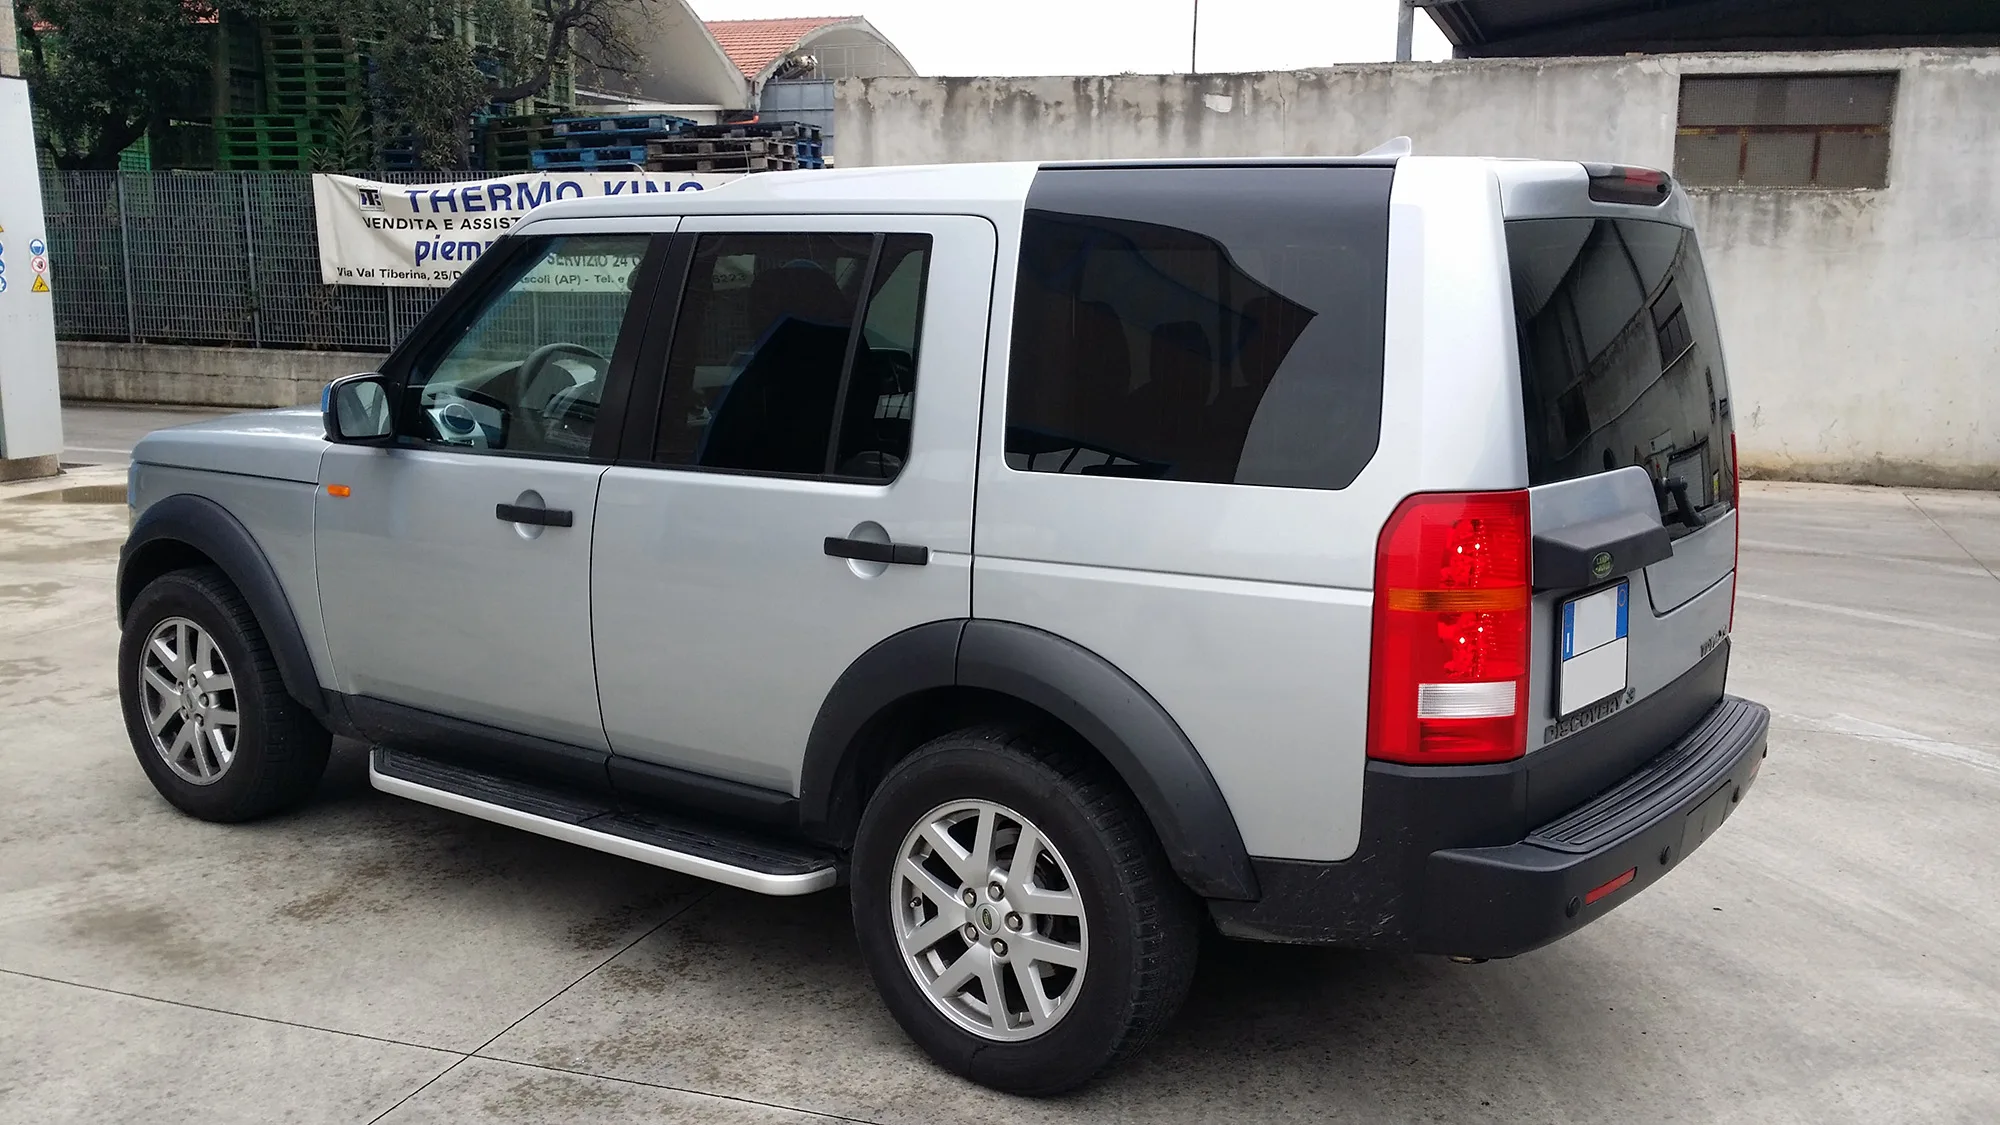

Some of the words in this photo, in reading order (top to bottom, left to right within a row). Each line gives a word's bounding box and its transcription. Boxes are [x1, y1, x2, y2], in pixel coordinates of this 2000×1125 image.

[404, 181, 583, 213] THERMO
[362, 217, 437, 230] VENDITA
[444, 219, 453, 230] E
[547, 252, 607, 267] SERVIZIO
[612, 255, 628, 267] 24
[337, 267, 353, 277] Via
[357, 268, 375, 278] Val
[379, 269, 430, 281] Tiberina,
[555, 274, 580, 286] (AP)
[594, 274, 614, 284] Tel.
[1544, 693, 1623, 744] DISCOVERY
[1626, 687, 1636, 705] 3
